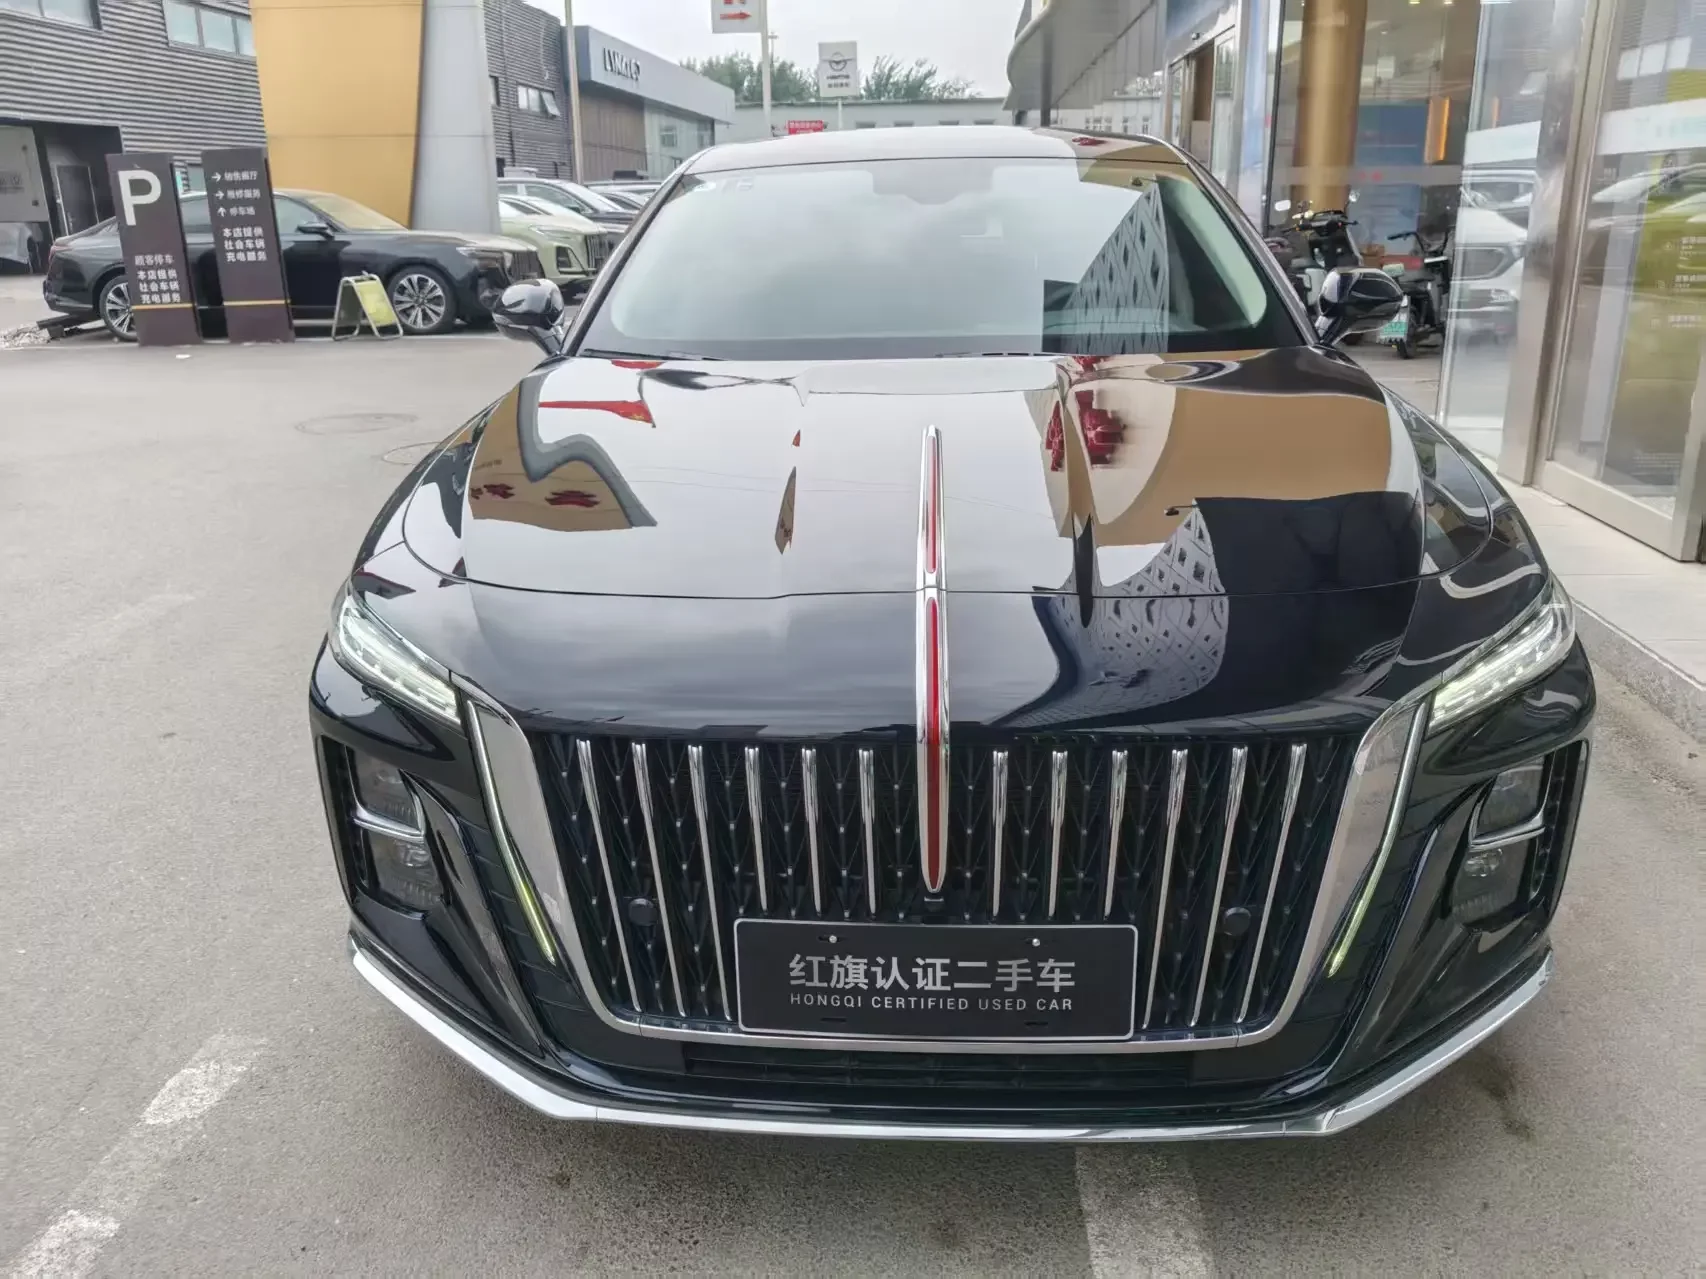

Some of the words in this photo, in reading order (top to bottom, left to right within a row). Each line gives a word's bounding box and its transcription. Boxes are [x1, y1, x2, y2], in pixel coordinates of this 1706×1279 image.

[117, 170, 161, 226] P
[223, 227, 263, 237] 本店提供
[224, 239, 265, 250] 社会车辆
[226, 251, 267, 262] 充电服务
[137, 268, 177, 280] 本店提供
[139, 280, 179, 292] 社会车辆
[141, 292, 181, 304] 充电服务
[789, 953, 1076, 992] 红旗认证二手车
[790, 993, 862, 1008] HONGQI
[871, 996, 968, 1010] CERTIFIED
[978, 998, 1027, 1011] USED
[1036, 998, 1073, 1011] CAR
